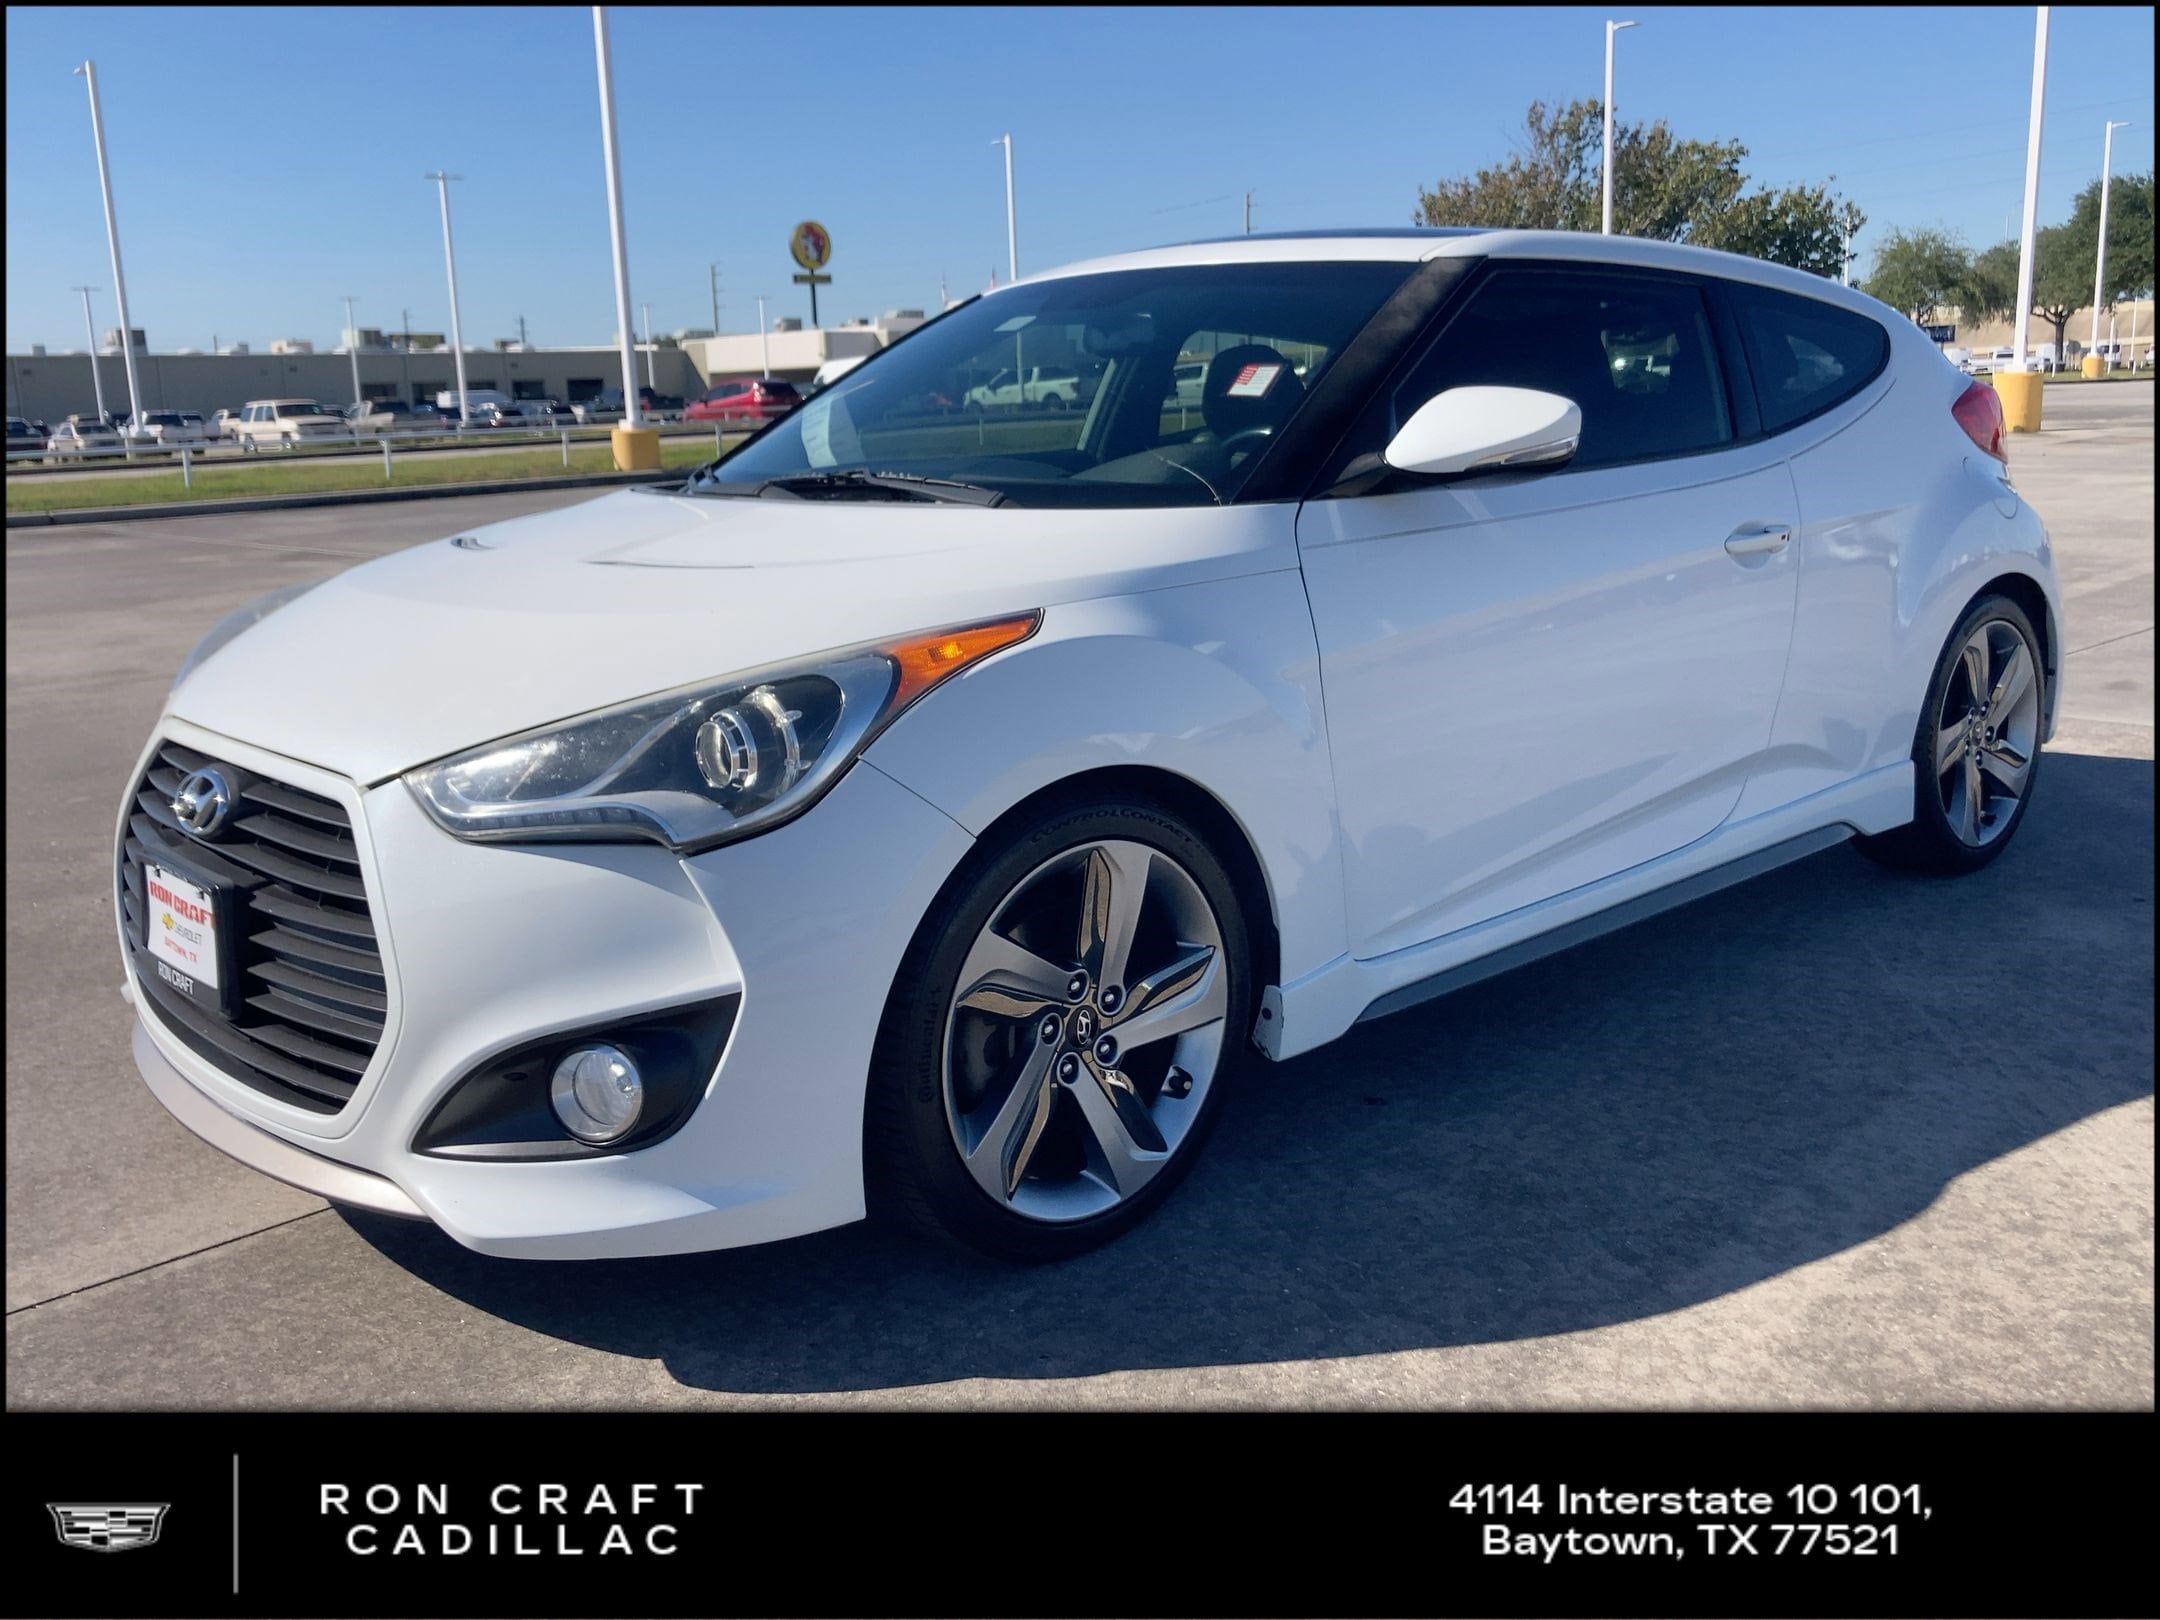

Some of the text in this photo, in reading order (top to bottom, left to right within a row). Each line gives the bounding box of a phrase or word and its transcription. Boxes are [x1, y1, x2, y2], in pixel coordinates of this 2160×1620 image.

[149, 880, 216, 929] RON CRAFT
[157, 961, 195, 996] RON CRAFT
